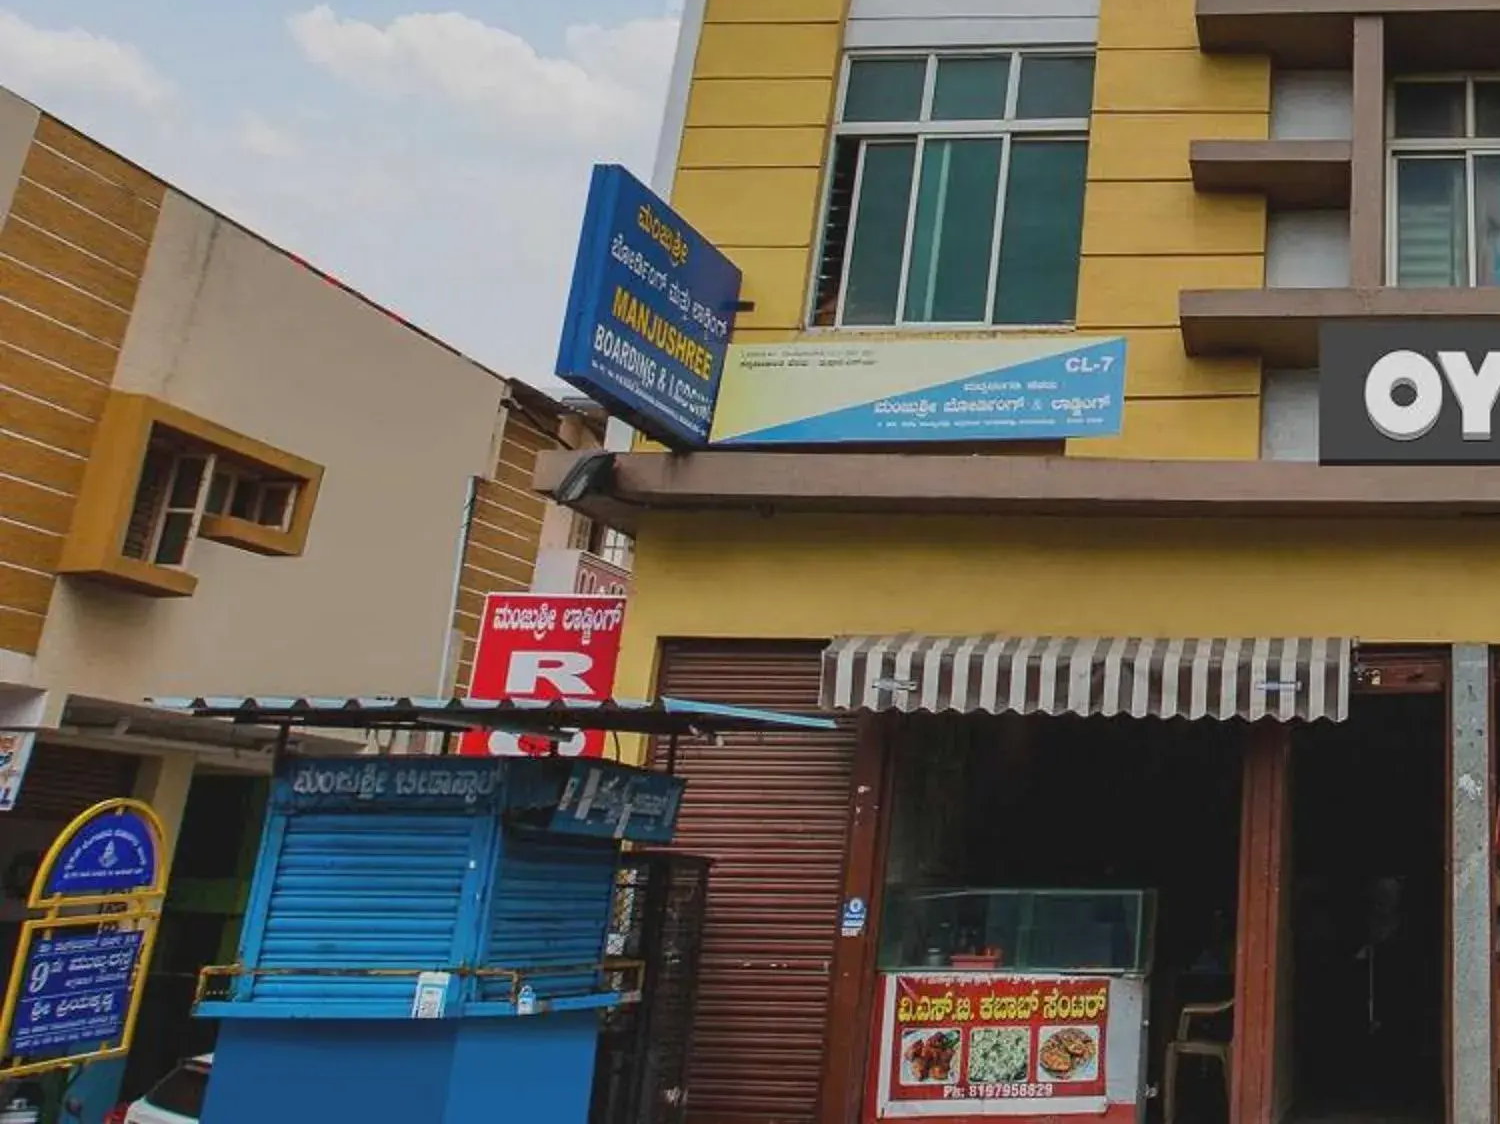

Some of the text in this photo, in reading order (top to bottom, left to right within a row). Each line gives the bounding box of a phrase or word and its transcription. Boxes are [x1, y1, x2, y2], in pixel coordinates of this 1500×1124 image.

[594, 324, 657, 389] BOARDING
[611, 284, 714, 381] MANJUSHREE
[1064, 356, 1113, 373] CL-7
[505, 651, 596, 695] R
